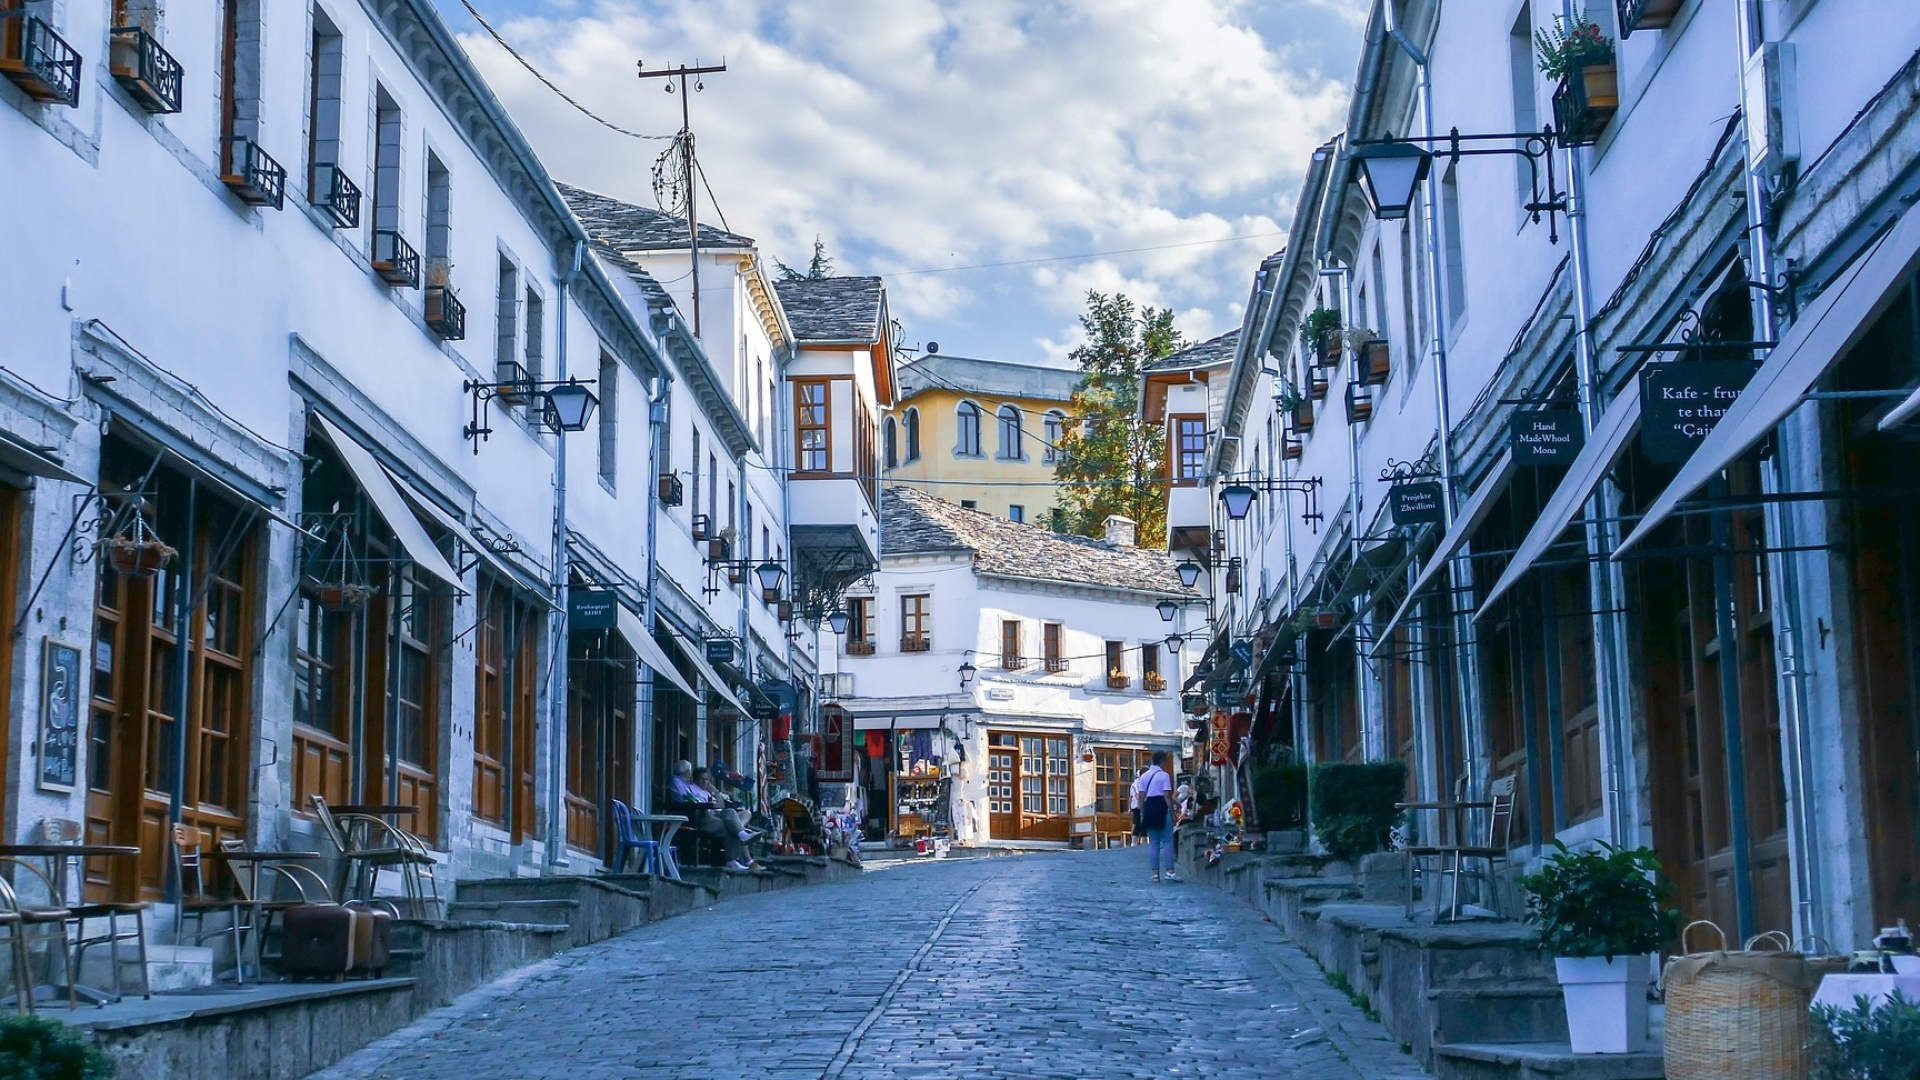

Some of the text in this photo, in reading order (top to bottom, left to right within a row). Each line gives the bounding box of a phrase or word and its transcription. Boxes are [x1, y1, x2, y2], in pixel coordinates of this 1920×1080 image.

[1662, 386, 1698, 399] Kafe
[1678, 408, 1692, 417] te
[1533, 422, 1556, 431] Hand
[1532, 446, 1557, 454] Mona
[1401, 492, 1432, 502] Projekte
